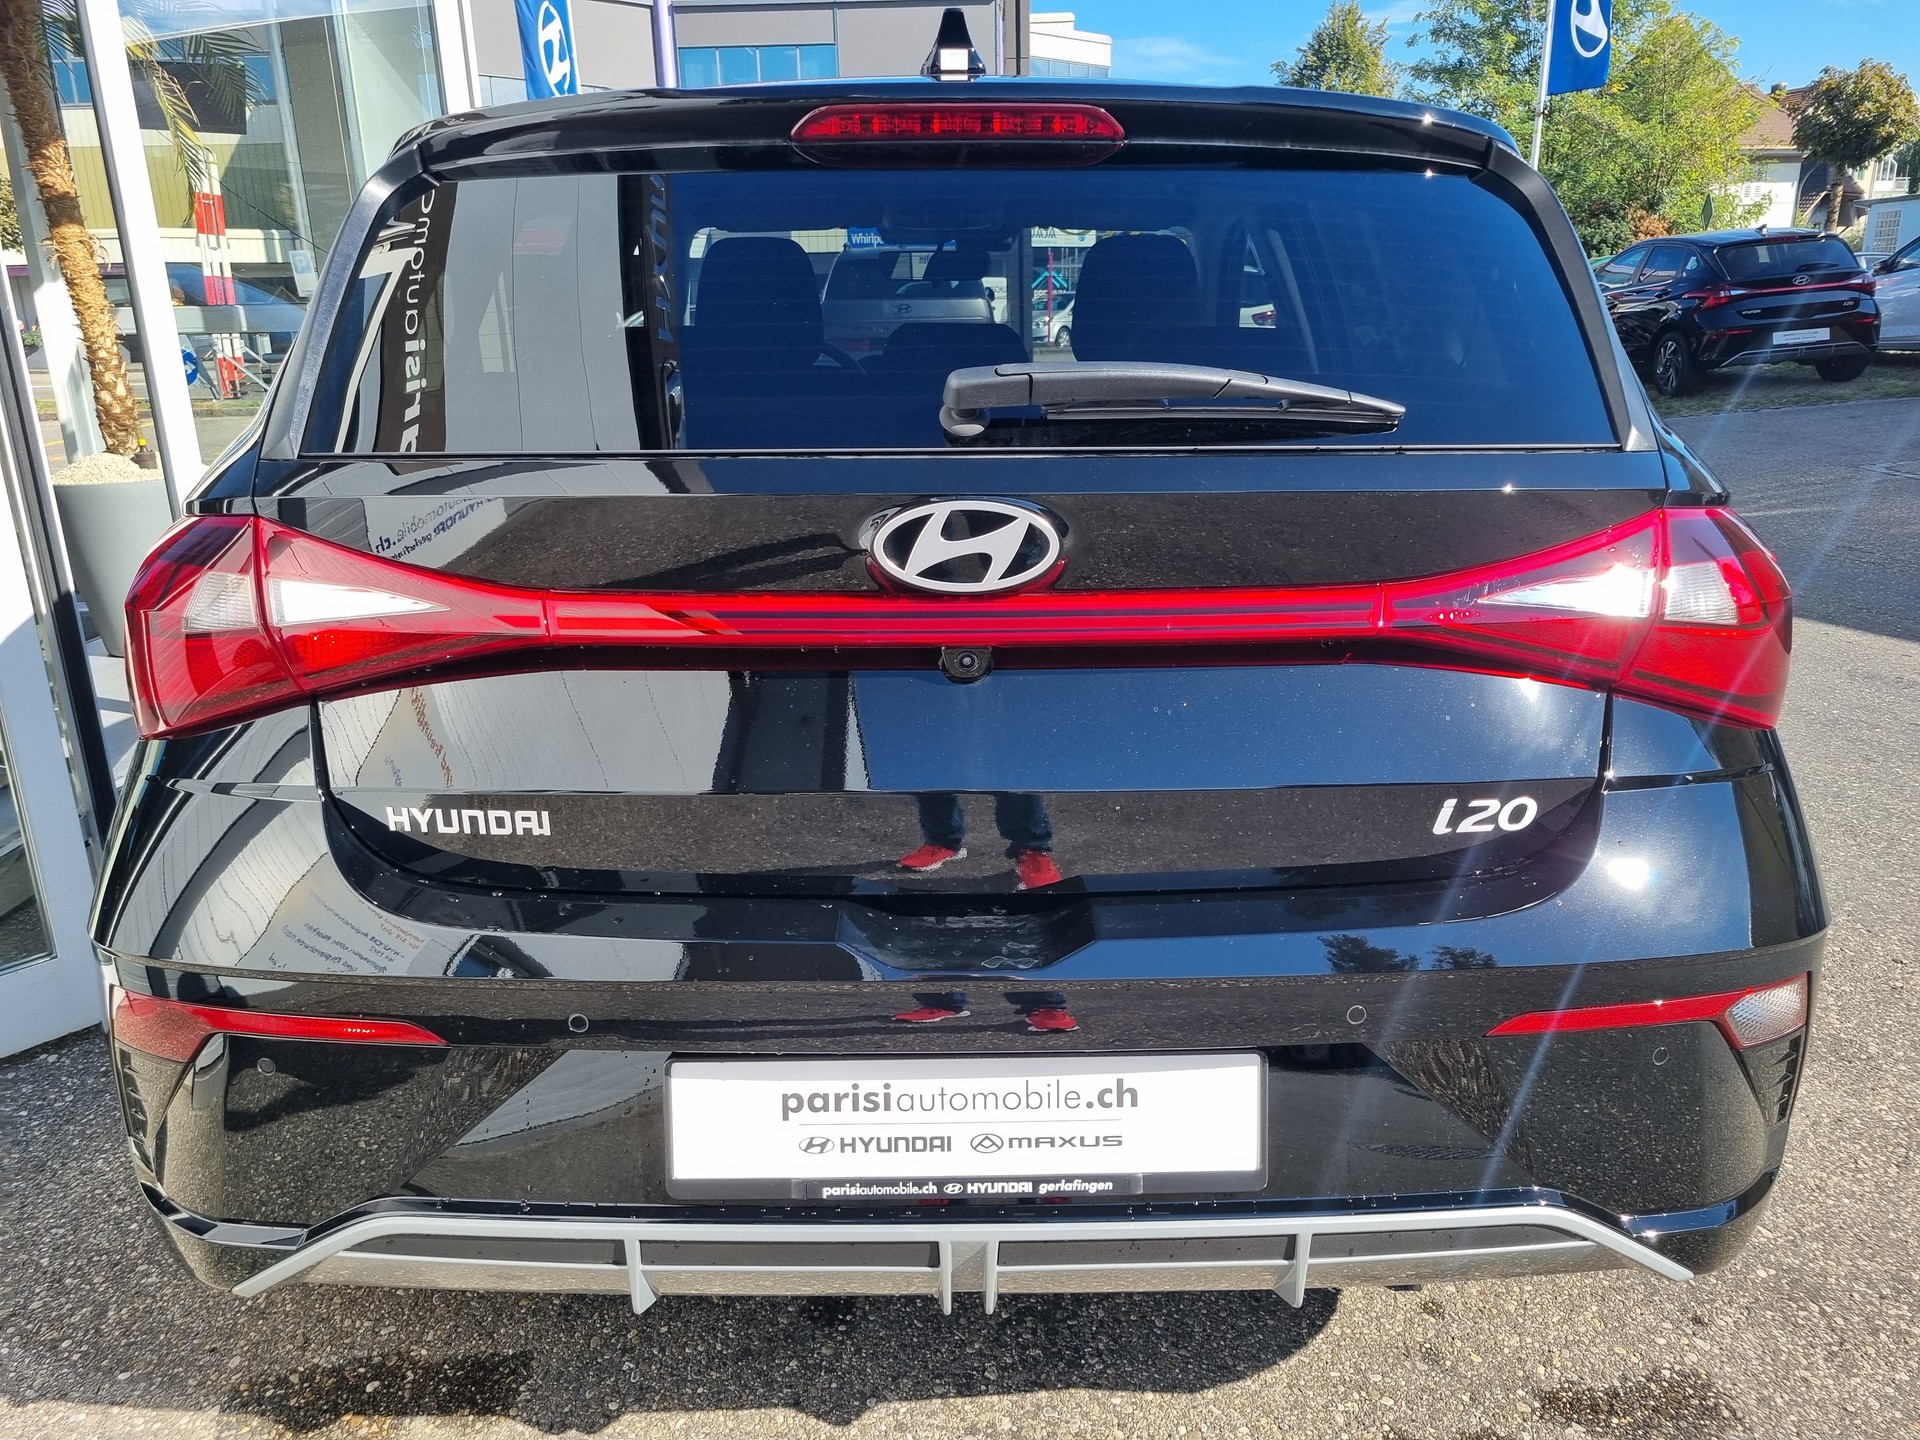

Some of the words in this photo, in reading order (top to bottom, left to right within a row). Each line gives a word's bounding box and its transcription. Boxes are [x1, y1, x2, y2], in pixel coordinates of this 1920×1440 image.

[386, 807, 551, 836] HYUNDAI
[1432, 797, 1538, 835] i20
[781, 1078, 1138, 1121] parisiautomobile.ch
[840, 1136, 951, 1153] HYUNDAI
[1008, 1135, 1122, 1149] MAXUS
[823, 1182, 937, 1199] parisiautomobile.ch
[967, 1182, 1033, 1194] HYUNDAI
[1039, 1179, 1113, 1194] gerlafingen
